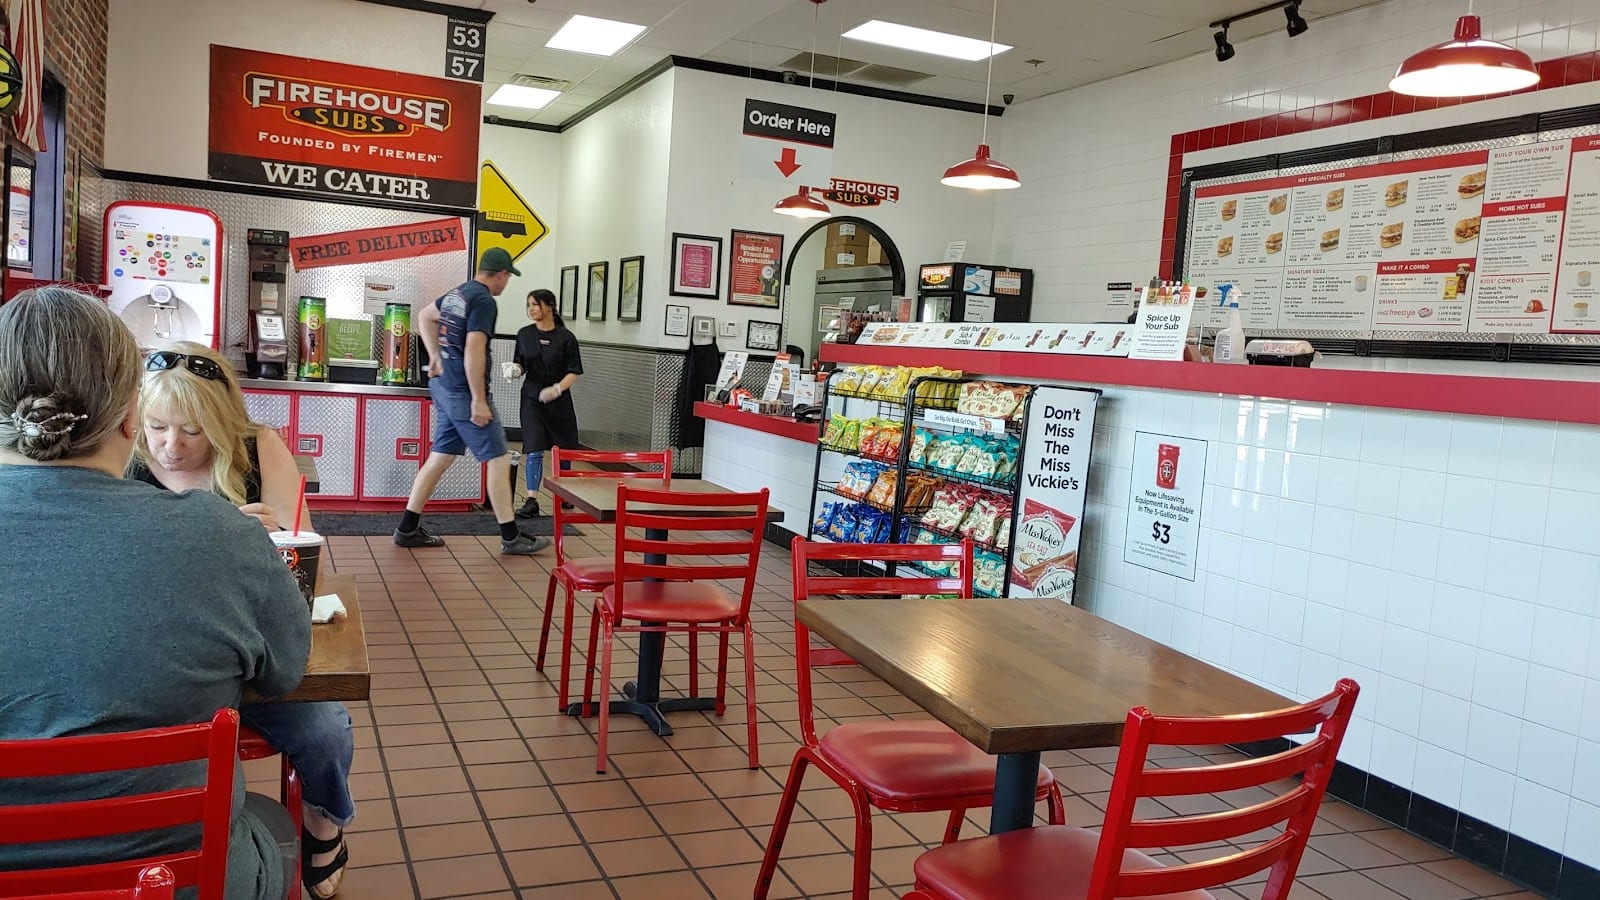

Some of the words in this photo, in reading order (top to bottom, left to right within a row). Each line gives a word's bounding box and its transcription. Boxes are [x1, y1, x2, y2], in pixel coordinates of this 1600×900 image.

[452, 26, 480, 48] 53
[451, 56, 480, 78] 57
[252, 78, 446, 132] FIREHOUSE
[314, 108, 386, 132] SUBS
[749, 110, 794, 130] Order
[796, 118, 830, 136] Here
[258, 132, 336, 150] FOUNDED
[342, 142, 361, 154] BY
[261, 162, 317, 188] WE
[324, 168, 430, 200] CATER
[829, 181, 897, 204] REHOUSE
[836, 192, 869, 204] SUBS
[296, 240, 350, 262] FREE
[358, 226, 458, 254] DELIVERY
[1146, 314, 1168, 322] Spice
[1170, 314, 1180, 323] Up
[1389, 309, 1416, 318] freestyle
[1044, 406, 1081, 421] Don't
[1044, 423, 1075, 438] Miss
[1044, 440, 1070, 455] The
[1040, 458, 1070, 472] Miss
[1028, 474, 1079, 490] Vickie's
[1135, 496, 1163, 508] Equipment
[1170, 504, 1194, 514] Available
[1145, 490, 1157, 498] Now
[1158, 493, 1185, 504] Lifesaving
[1154, 509, 1176, 520] 5-Gallon
[1178, 514, 1189, 522] Size
[1152, 520, 1171, 544] $3
[1037, 545, 1048, 554] SALT
